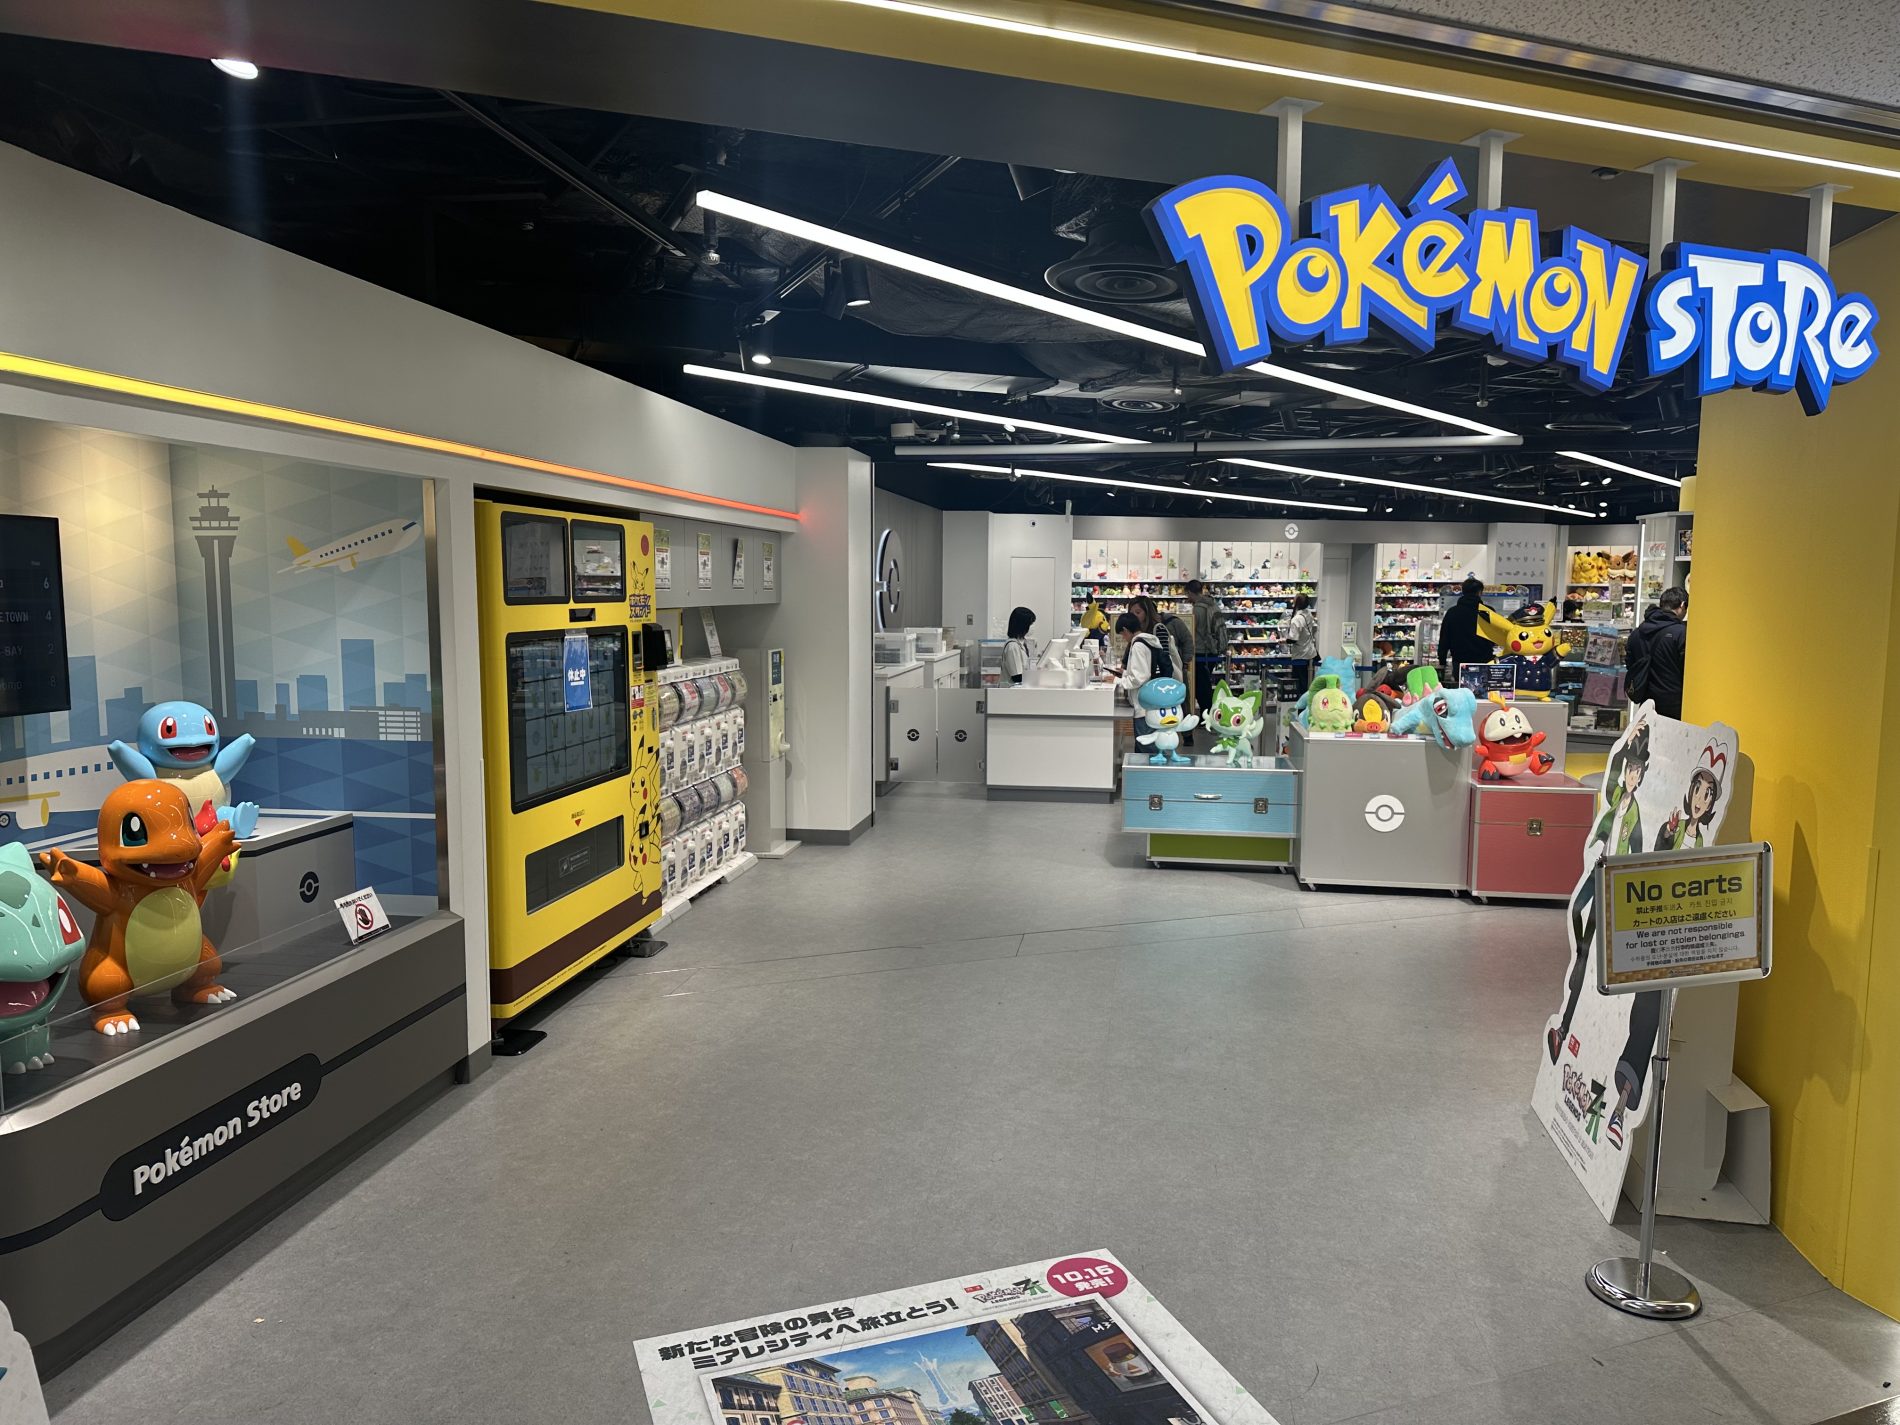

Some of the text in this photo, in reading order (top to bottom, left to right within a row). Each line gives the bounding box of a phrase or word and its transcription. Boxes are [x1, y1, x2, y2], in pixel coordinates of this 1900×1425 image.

[1626, 874, 1743, 904] No carts
[1625, 941, 1639, 950] for
[1640, 939, 1657, 949] lost
[1670, 935, 1697, 946] stolen
[1699, 930, 1745, 943] belongings
[1636, 921, 1733, 939] We are not responsible
[133, 1082, 302, 1196] Pokémon Store
[1052, 1264, 1115, 1284] 10.16
[658, 1306, 855, 1361] 新たな冒険の舞台
